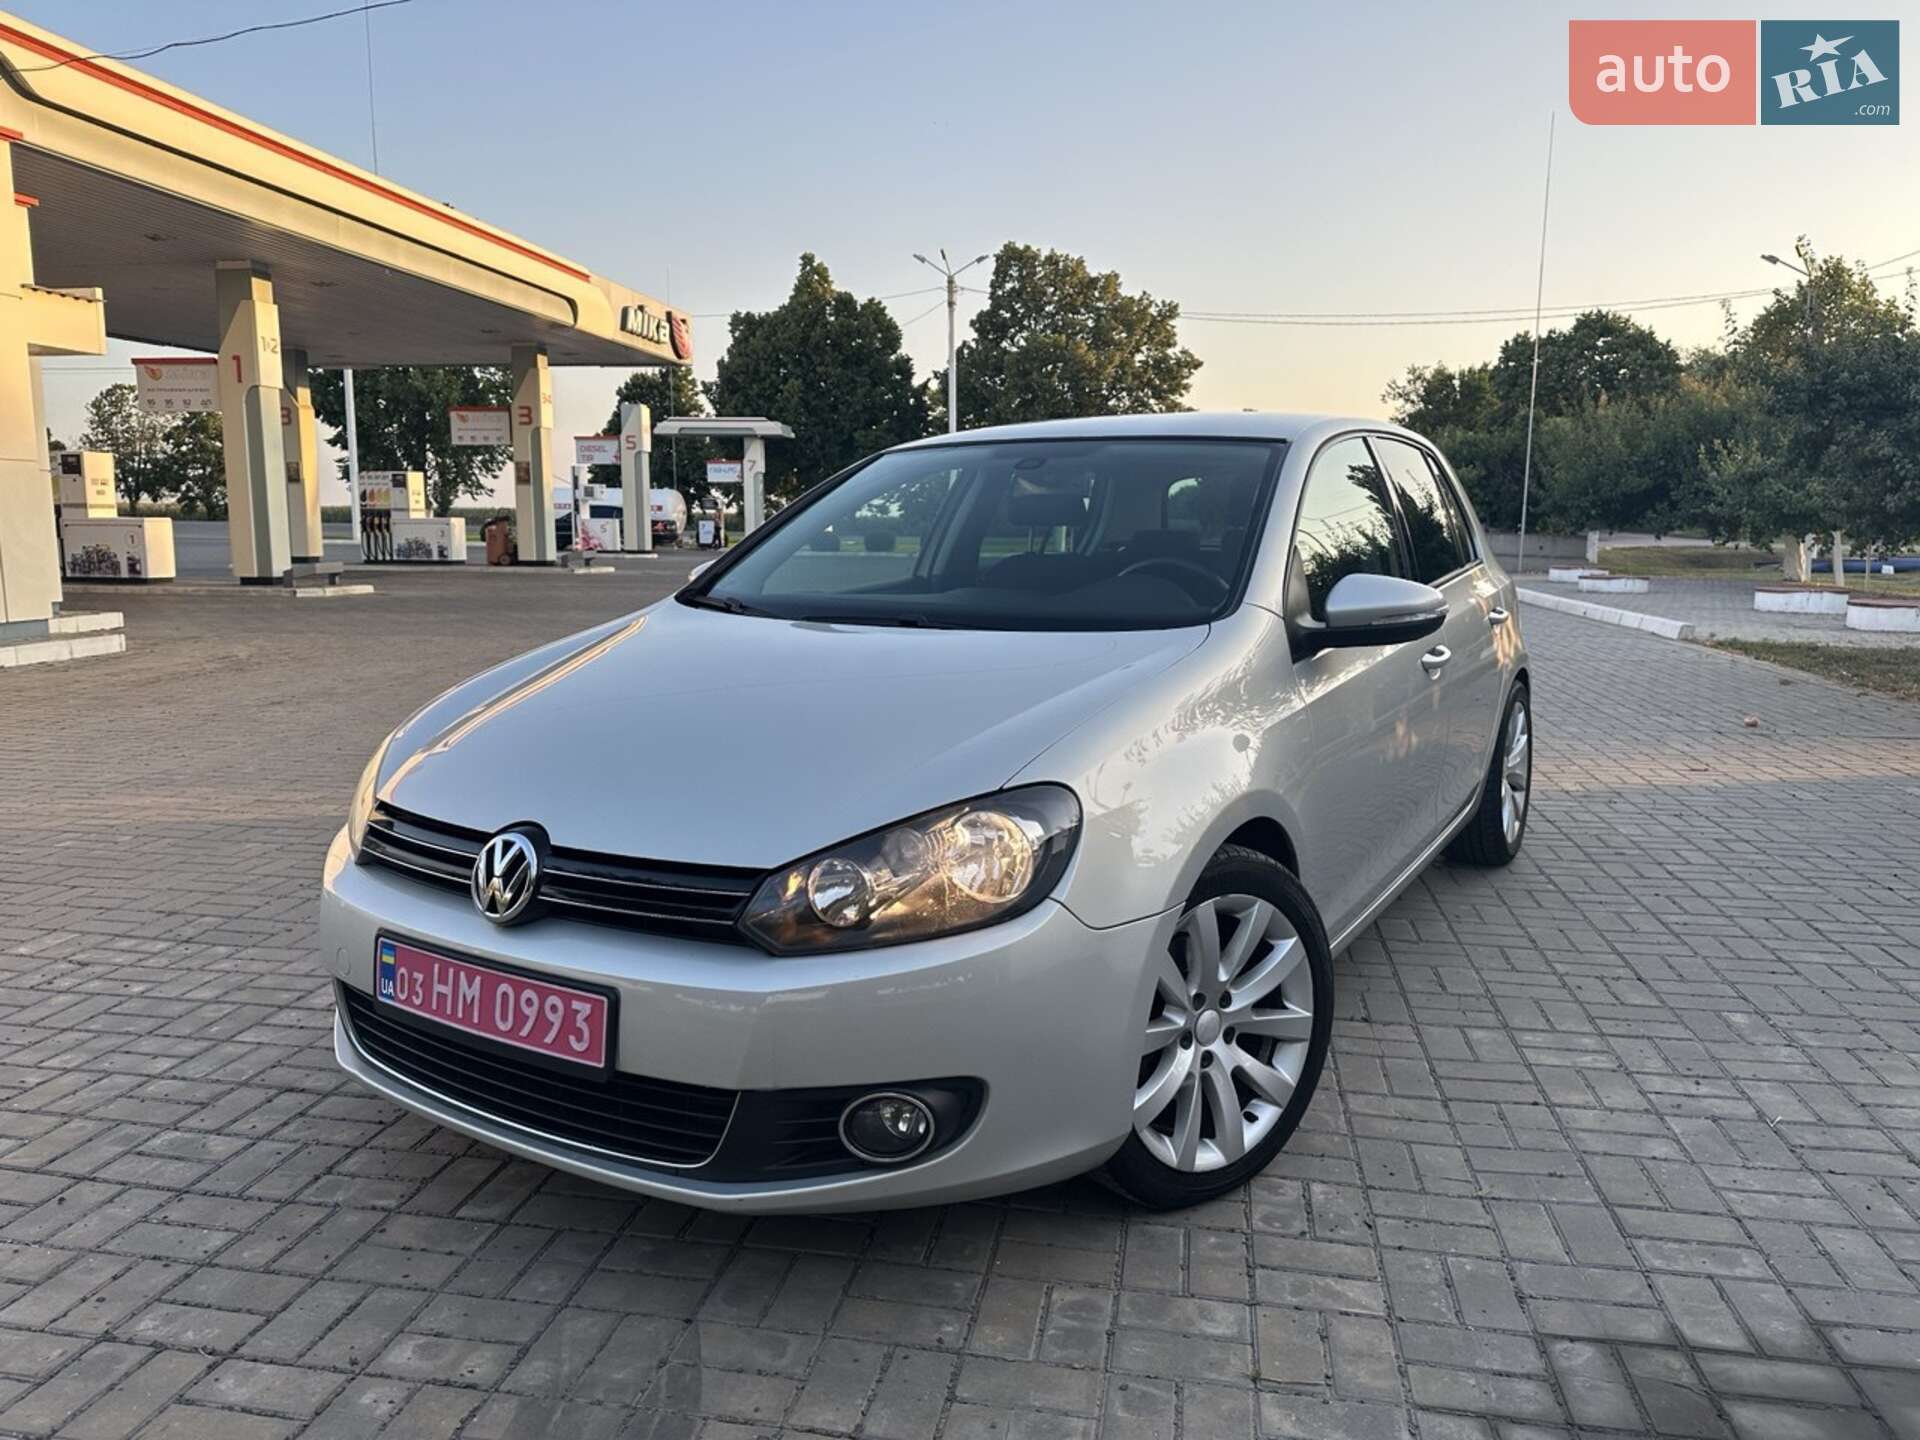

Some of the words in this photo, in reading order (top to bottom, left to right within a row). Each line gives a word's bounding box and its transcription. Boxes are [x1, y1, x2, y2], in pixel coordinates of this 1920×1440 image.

[232, 354, 243, 383] 1
[517, 404, 533, 426] 3
[381, 978, 395, 998] UA
[396, 967, 424, 1005] 03
[431, 963, 482, 1024] HM
[494, 983, 594, 1052] 0993
